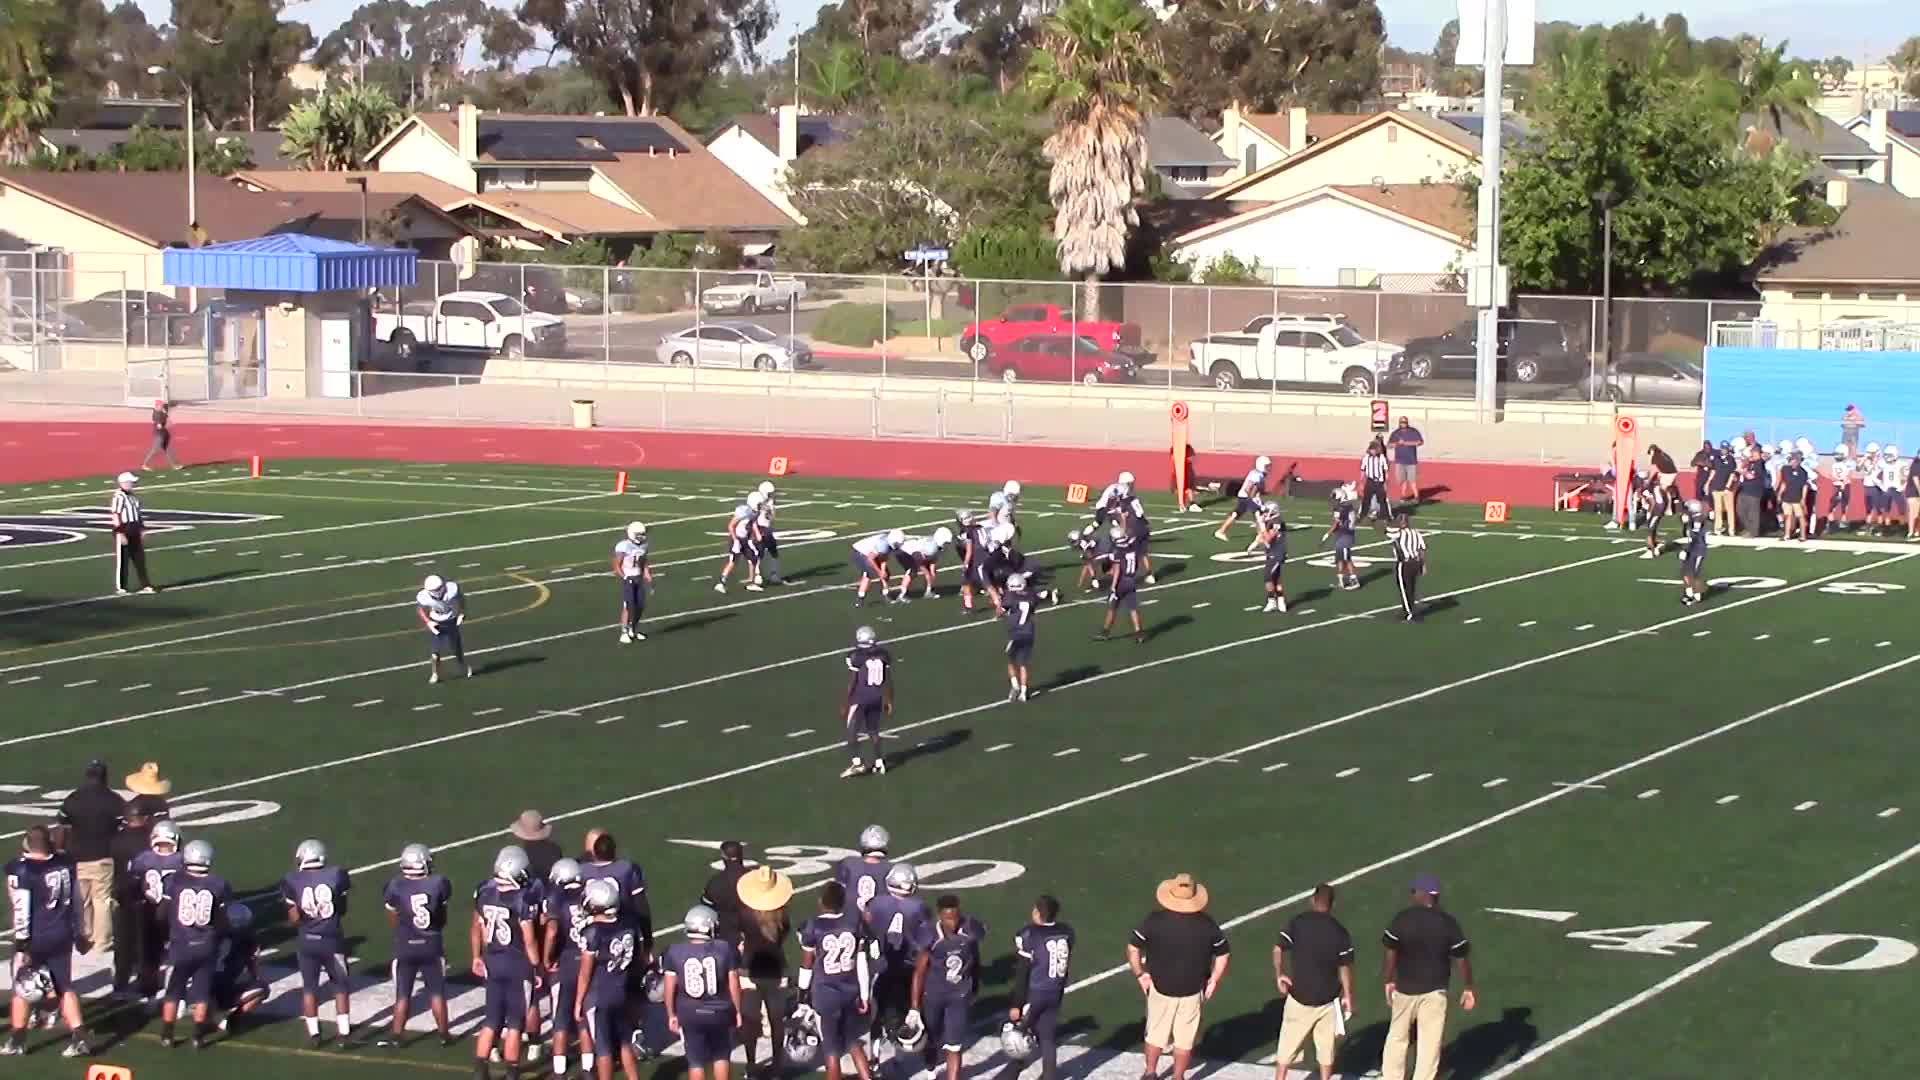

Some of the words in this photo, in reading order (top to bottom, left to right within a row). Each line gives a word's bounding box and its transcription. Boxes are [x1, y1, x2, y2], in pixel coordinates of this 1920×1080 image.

[1373, 404, 1387, 421] 2
[1071, 485, 1084, 499] 10
[1489, 504, 1502, 518] 20
[1019, 601, 1029, 625] 7
[866, 658, 884, 686] 10
[301, 883, 335, 920] 48
[410, 893, 431, 929] 5
[483, 904, 512, 946] 75
[822, 931, 856, 975] 22
[684, 955, 718, 998] 61
[945, 954, 962, 984] 2
